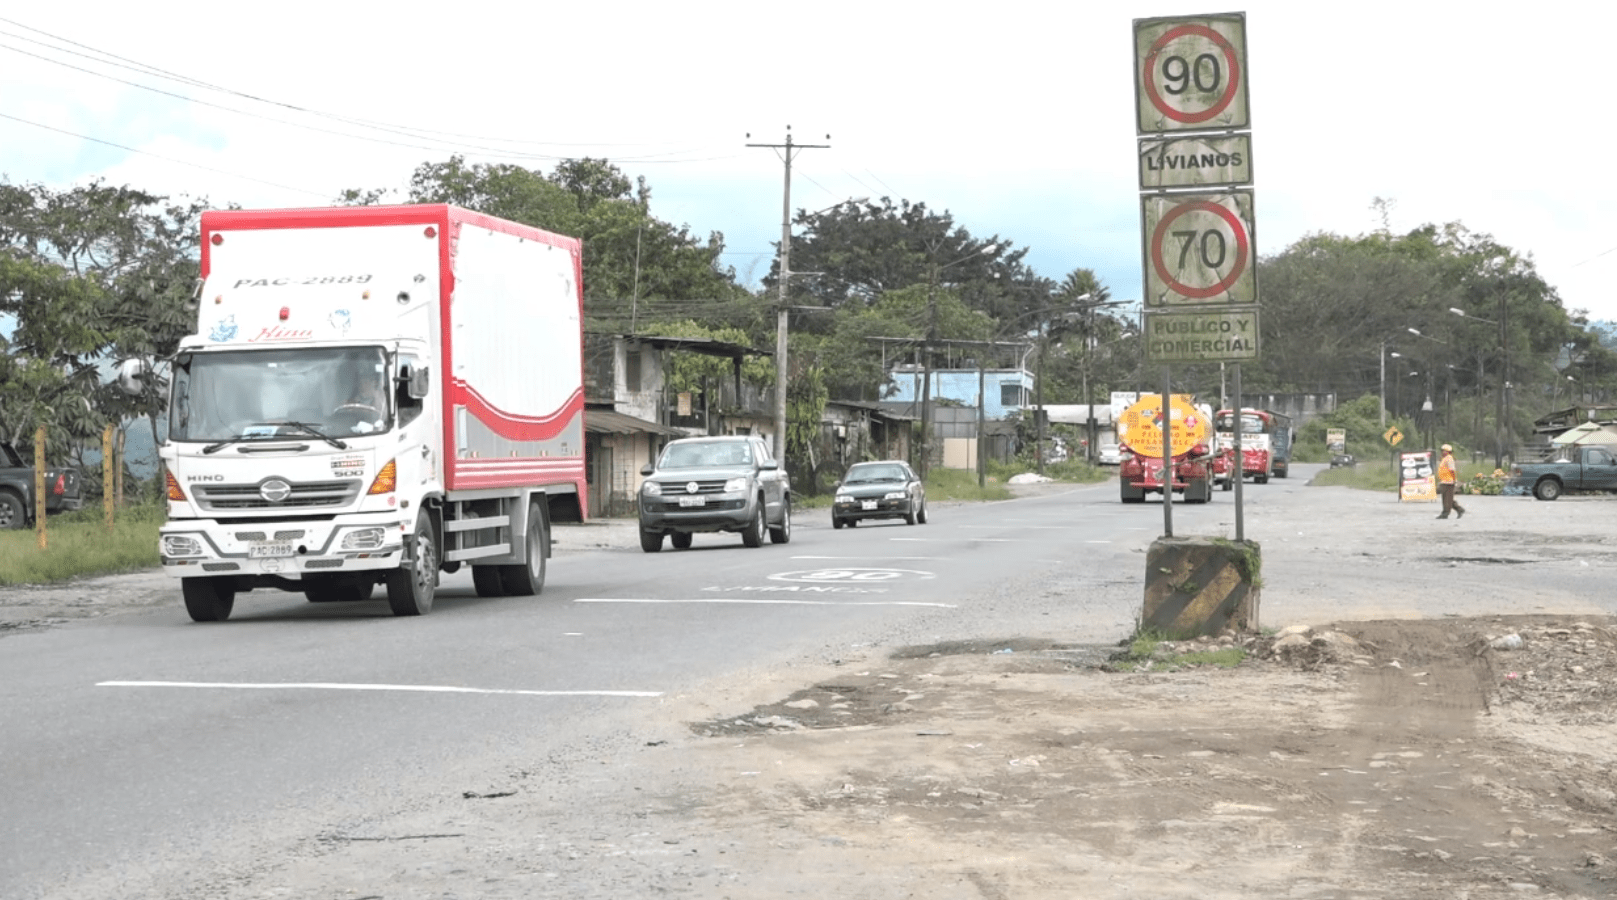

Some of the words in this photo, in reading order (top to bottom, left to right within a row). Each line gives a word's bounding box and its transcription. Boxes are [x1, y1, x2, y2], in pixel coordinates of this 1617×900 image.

[1162, 53, 1221, 95] 90
[1147, 152, 1243, 171] LIVIANOS
[1171, 229, 1226, 270] 70
[233, 274, 372, 289] PAC-2889
[1237, 319, 1249, 332] Y
[1150, 339, 1254, 353] COMERCIAL
[187, 474, 224, 482] HINO
[800, 570, 901, 580] 90
